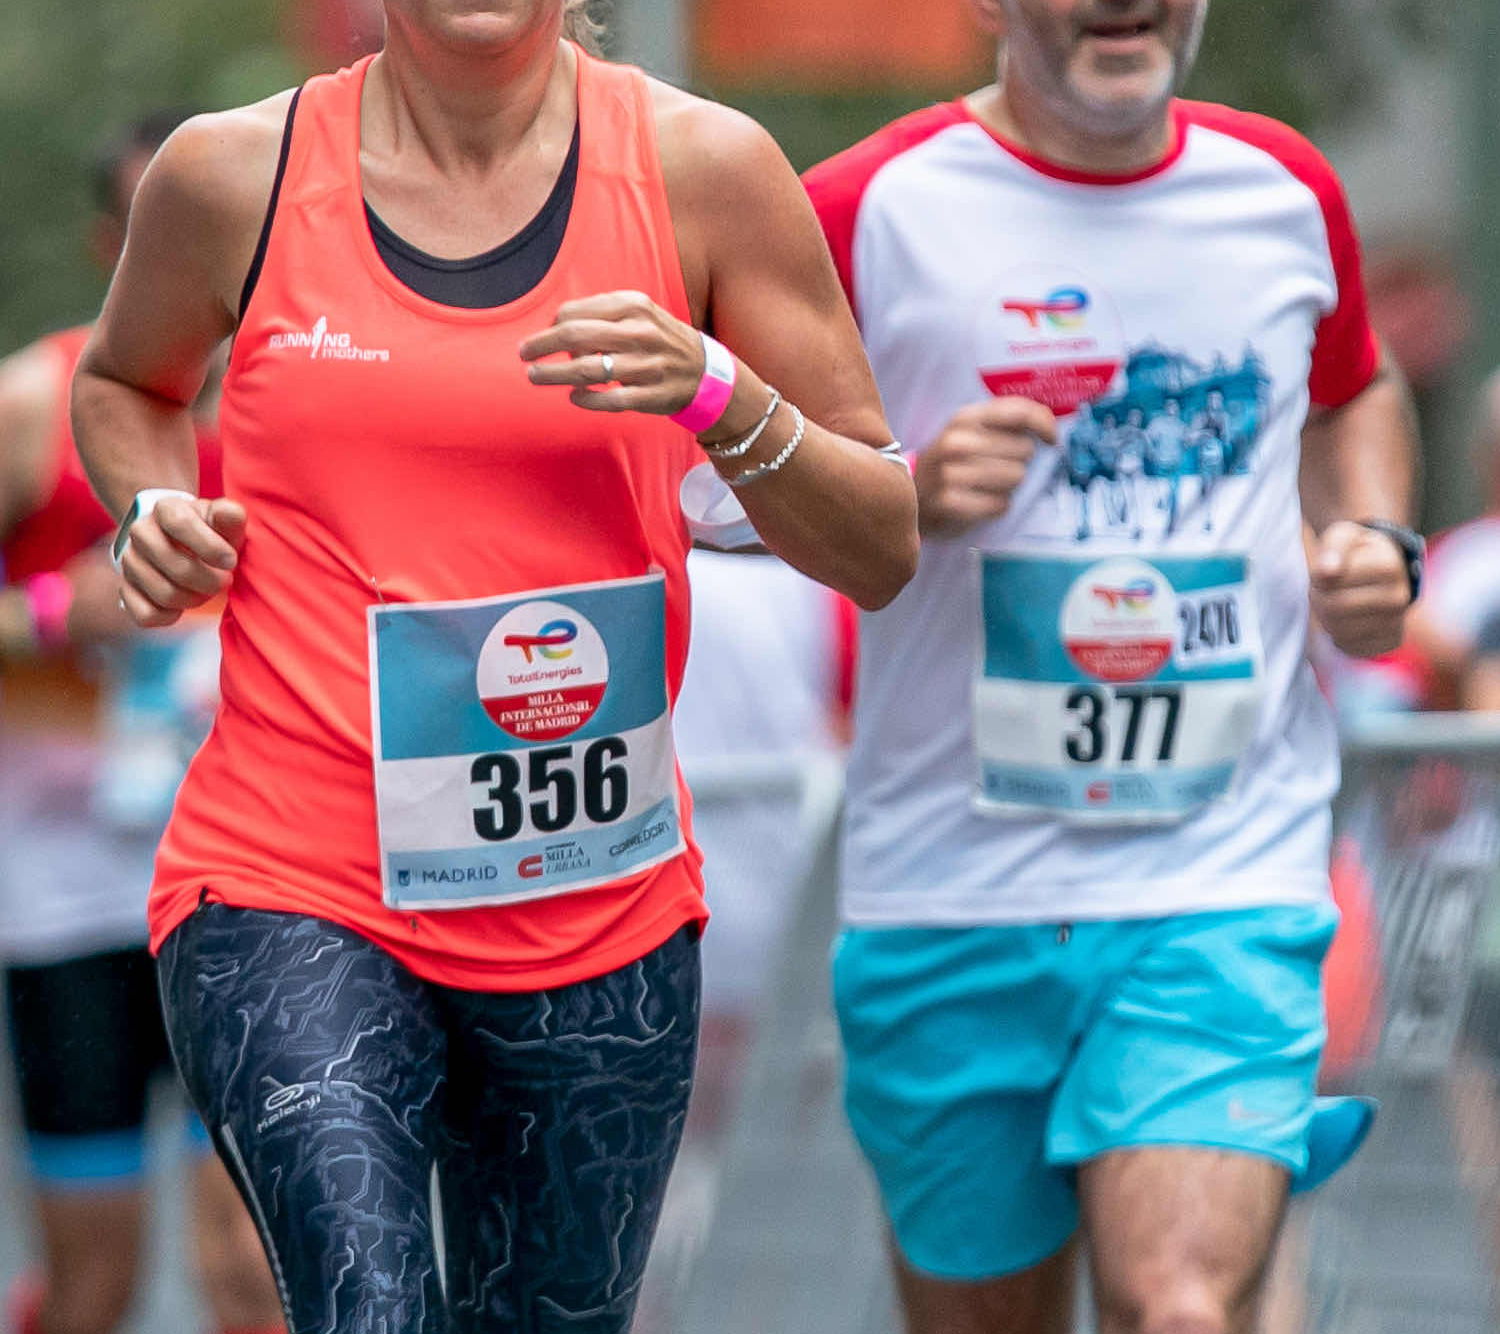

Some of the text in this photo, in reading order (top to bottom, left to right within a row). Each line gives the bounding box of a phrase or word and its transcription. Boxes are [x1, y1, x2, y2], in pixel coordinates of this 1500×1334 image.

[322, 346, 390, 362] mothers
[508, 666, 583, 684] TotalEnergies
[527, 692, 564, 706] MILLA
[535, 714, 581, 730] MADRID
[1064, 685, 1181, 763] 377
[470, 736, 629, 841] 356
[422, 865, 498, 883] MADRID
